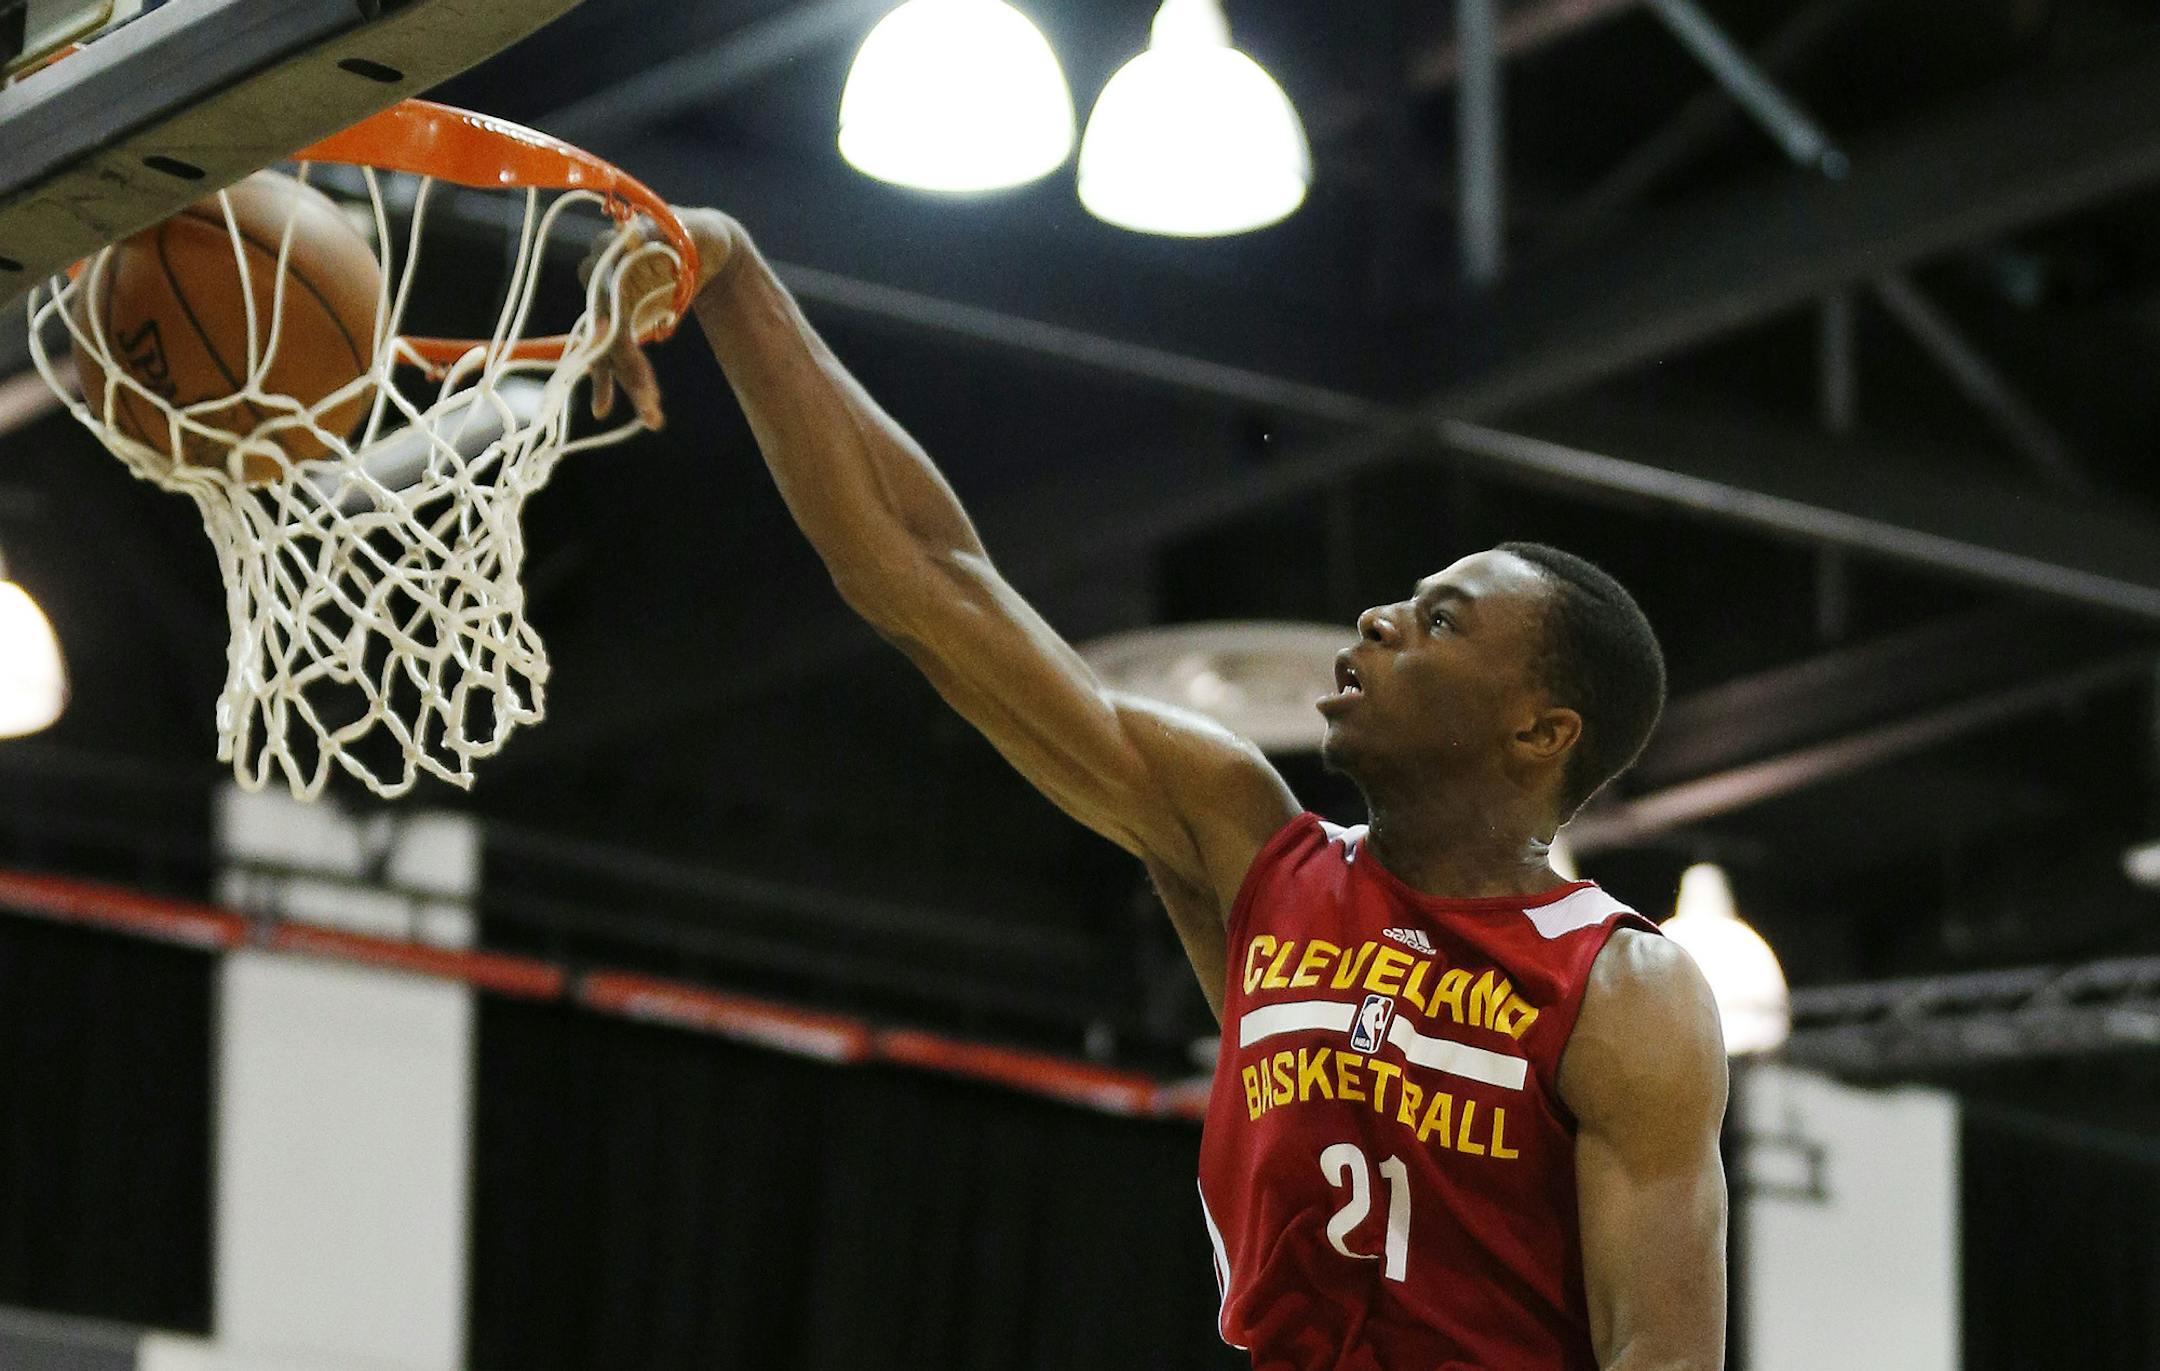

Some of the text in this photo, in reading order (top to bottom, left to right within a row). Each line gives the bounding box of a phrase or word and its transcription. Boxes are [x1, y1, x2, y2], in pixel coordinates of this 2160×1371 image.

[1243, 935, 1539, 1040] CLEVELAND
[1382, 928, 1437, 955] adidas
[1241, 1048, 1519, 1159] BASKETBALL
[1319, 1143, 1411, 1282] 21
